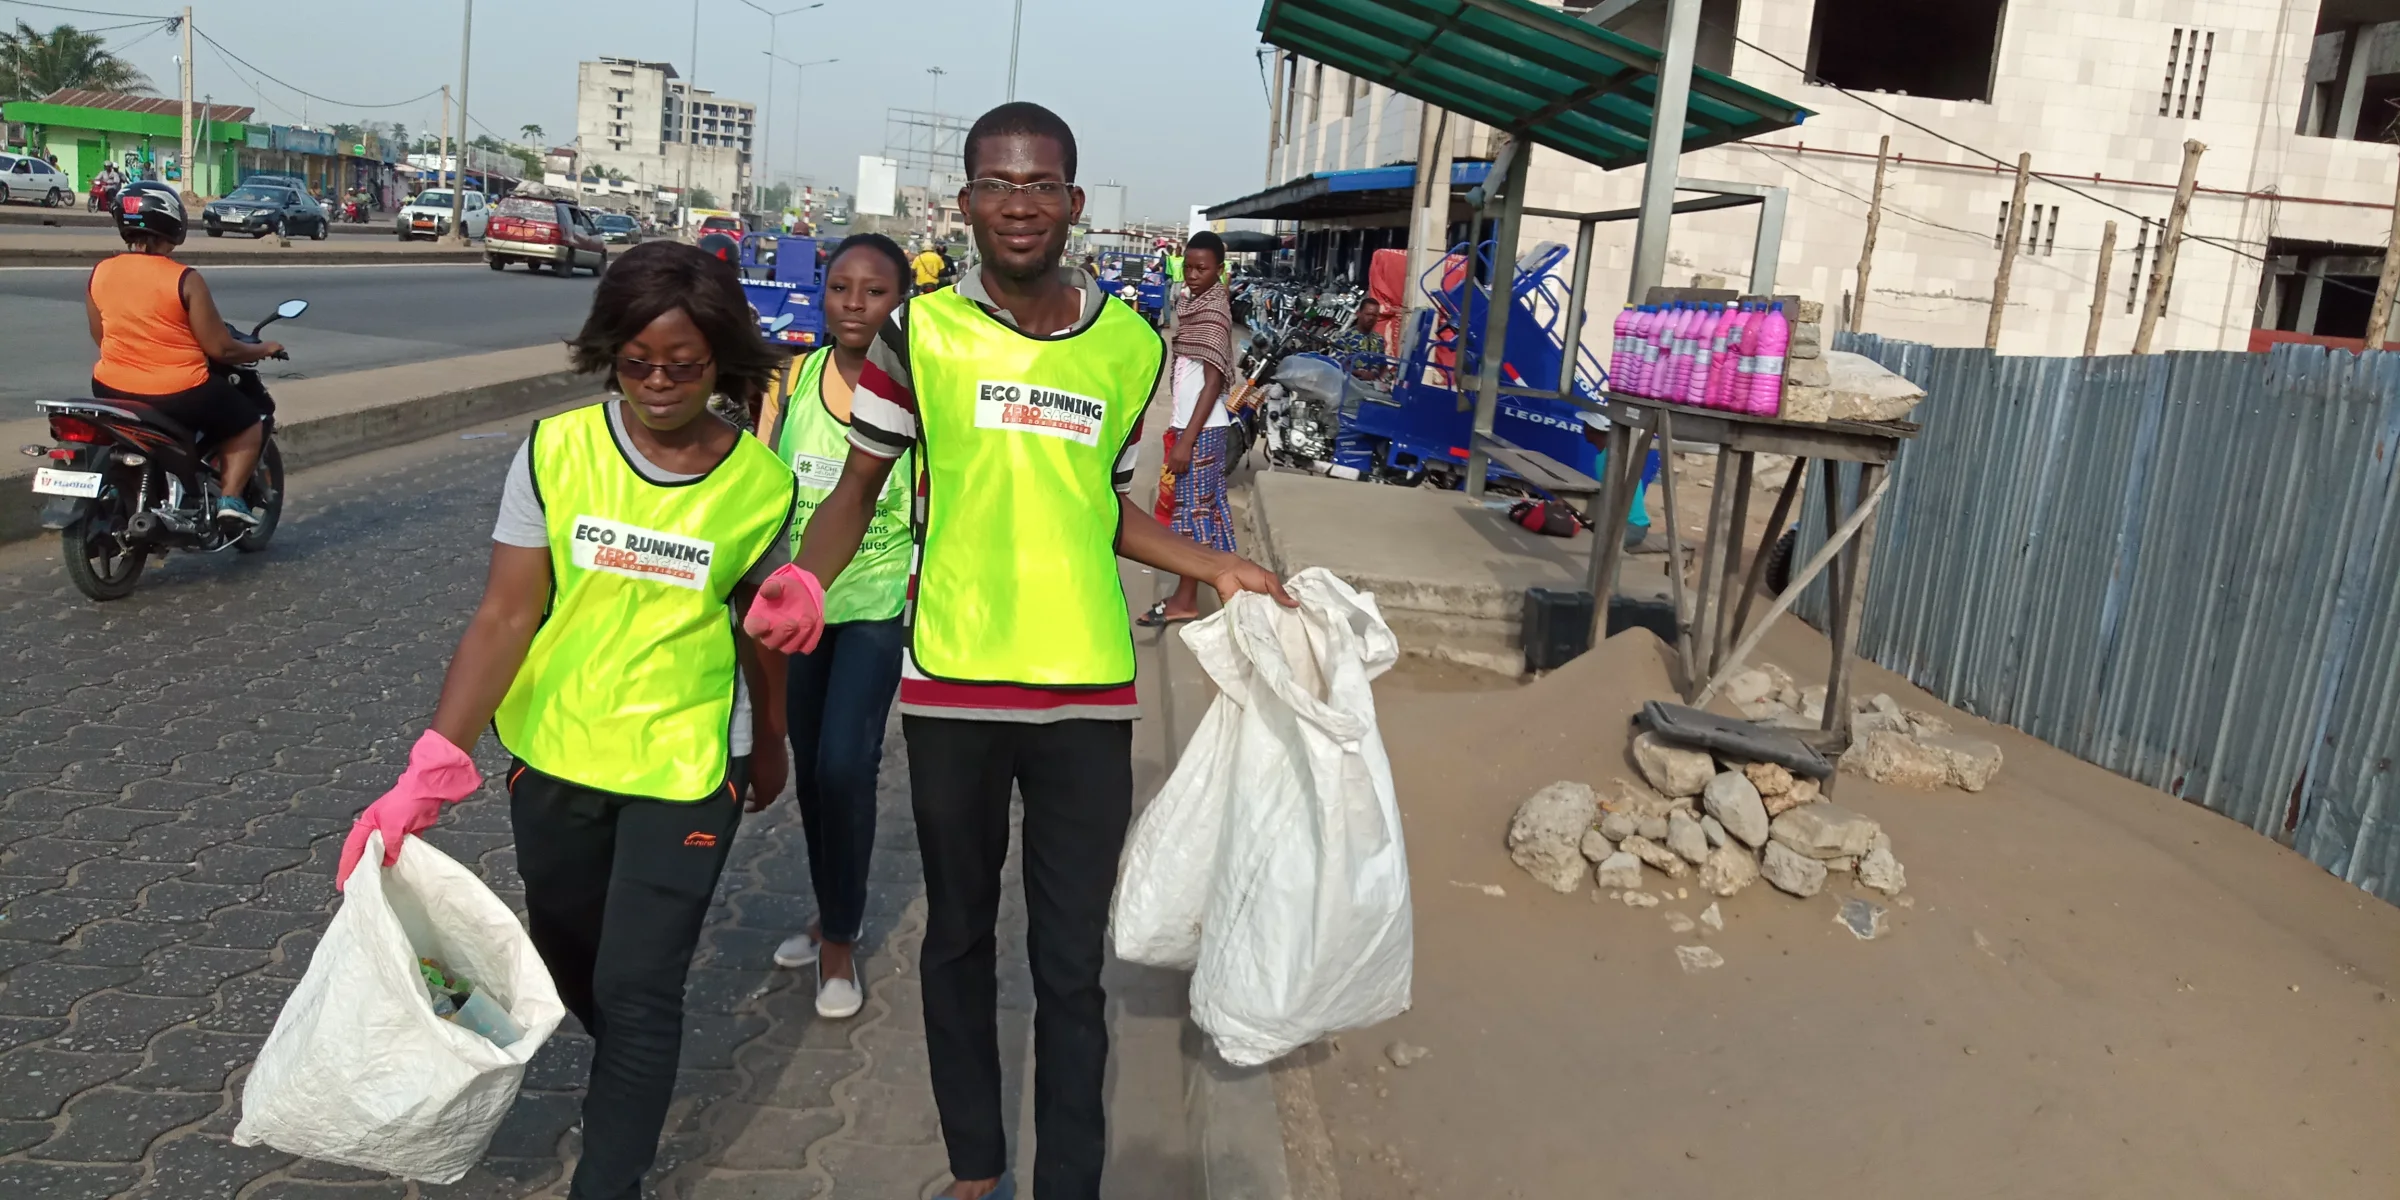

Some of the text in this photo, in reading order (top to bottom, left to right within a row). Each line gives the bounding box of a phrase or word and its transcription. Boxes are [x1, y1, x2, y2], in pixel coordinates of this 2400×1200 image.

[980, 384, 1103, 420] ECO RUNNING
[1003, 403, 1094, 427] ZERO SACHET
[1504, 406, 1584, 434] LEOPAR
[797, 500, 820, 509] our
[867, 525, 888, 534] ans
[575, 524, 711, 566] ECO RUNNING
[859, 541, 888, 553] ques
[594, 545, 699, 571] ZERO SACHET
